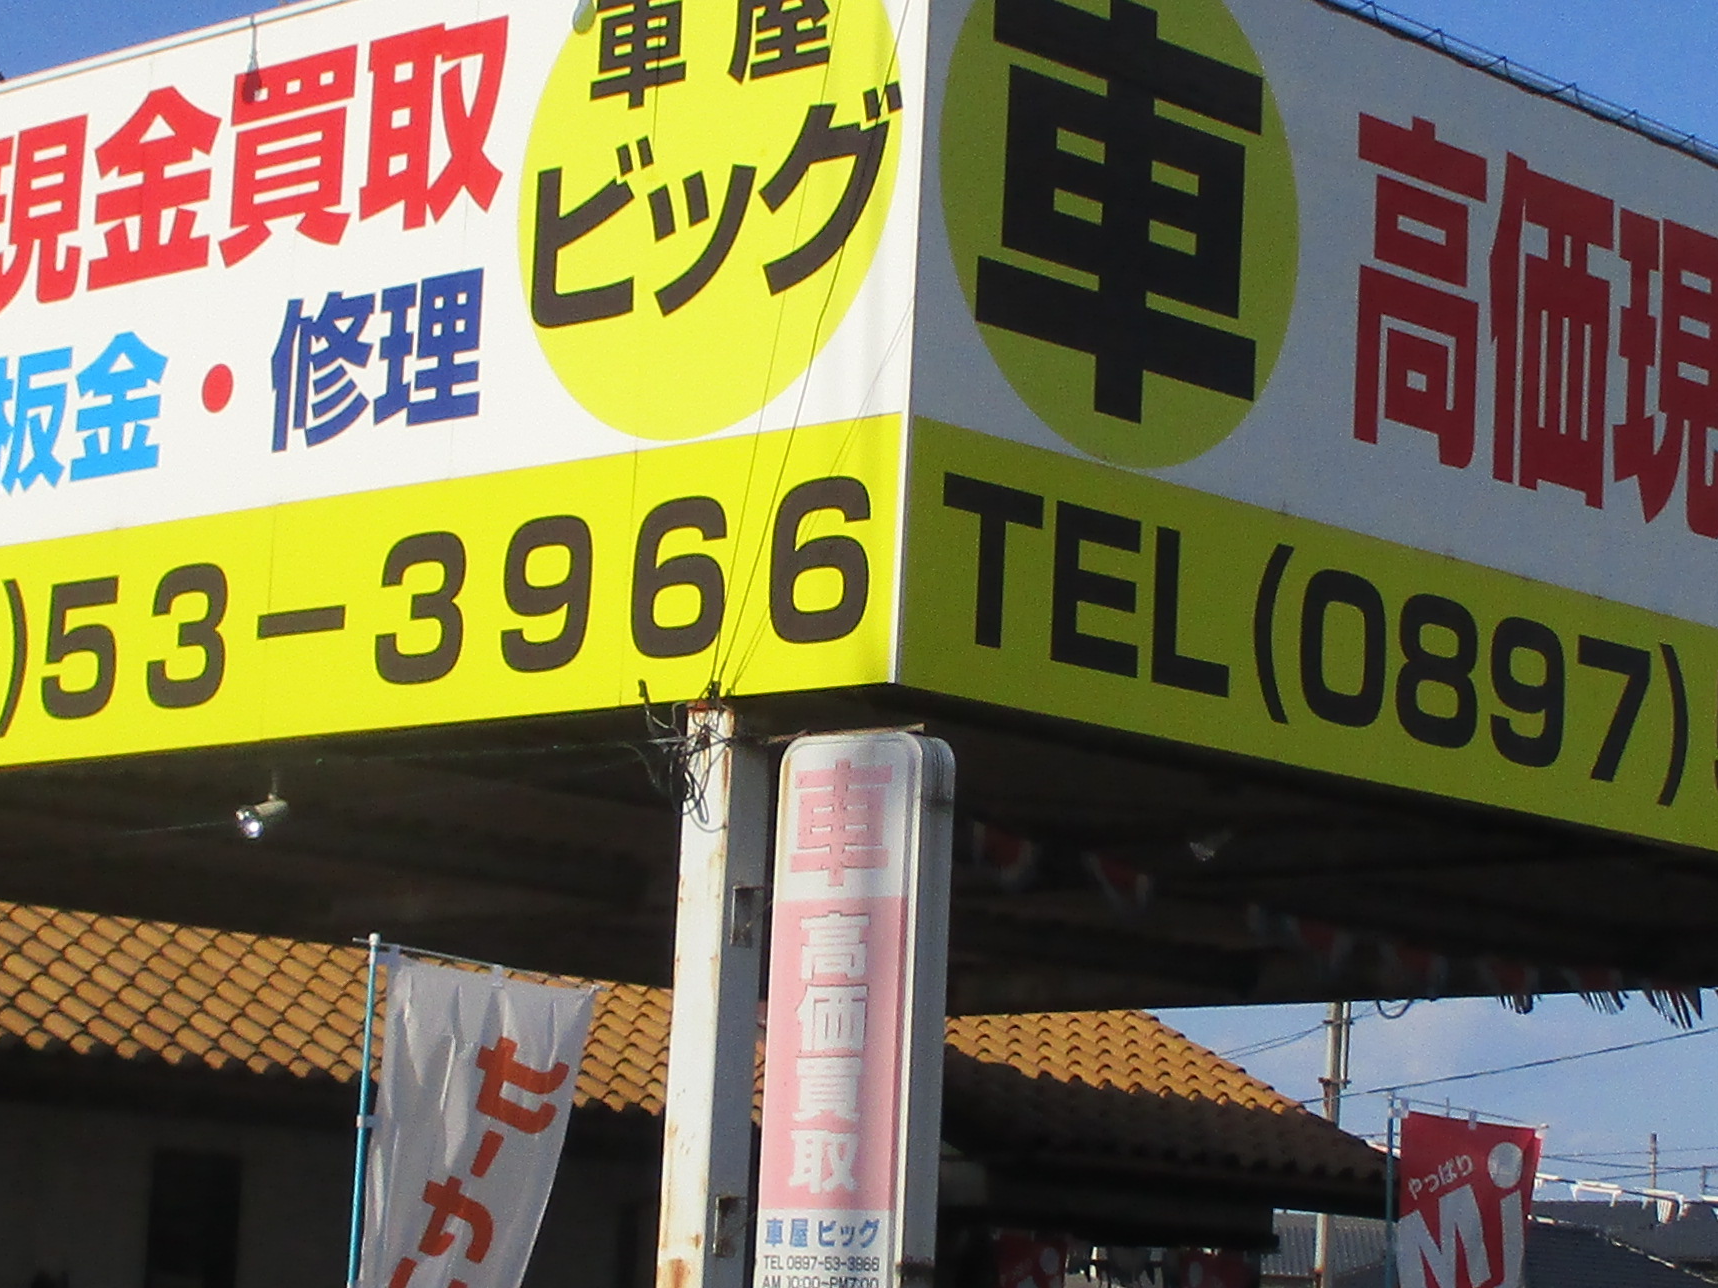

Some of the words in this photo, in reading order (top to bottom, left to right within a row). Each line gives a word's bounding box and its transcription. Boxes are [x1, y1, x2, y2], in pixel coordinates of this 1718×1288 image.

[531, 80, 902, 328] ビッグ
[790, 758, 893, 887] 車
[789, 911, 871, 1195] 高価買取
[1407, 1154, 1475, 1200] やっぱり
